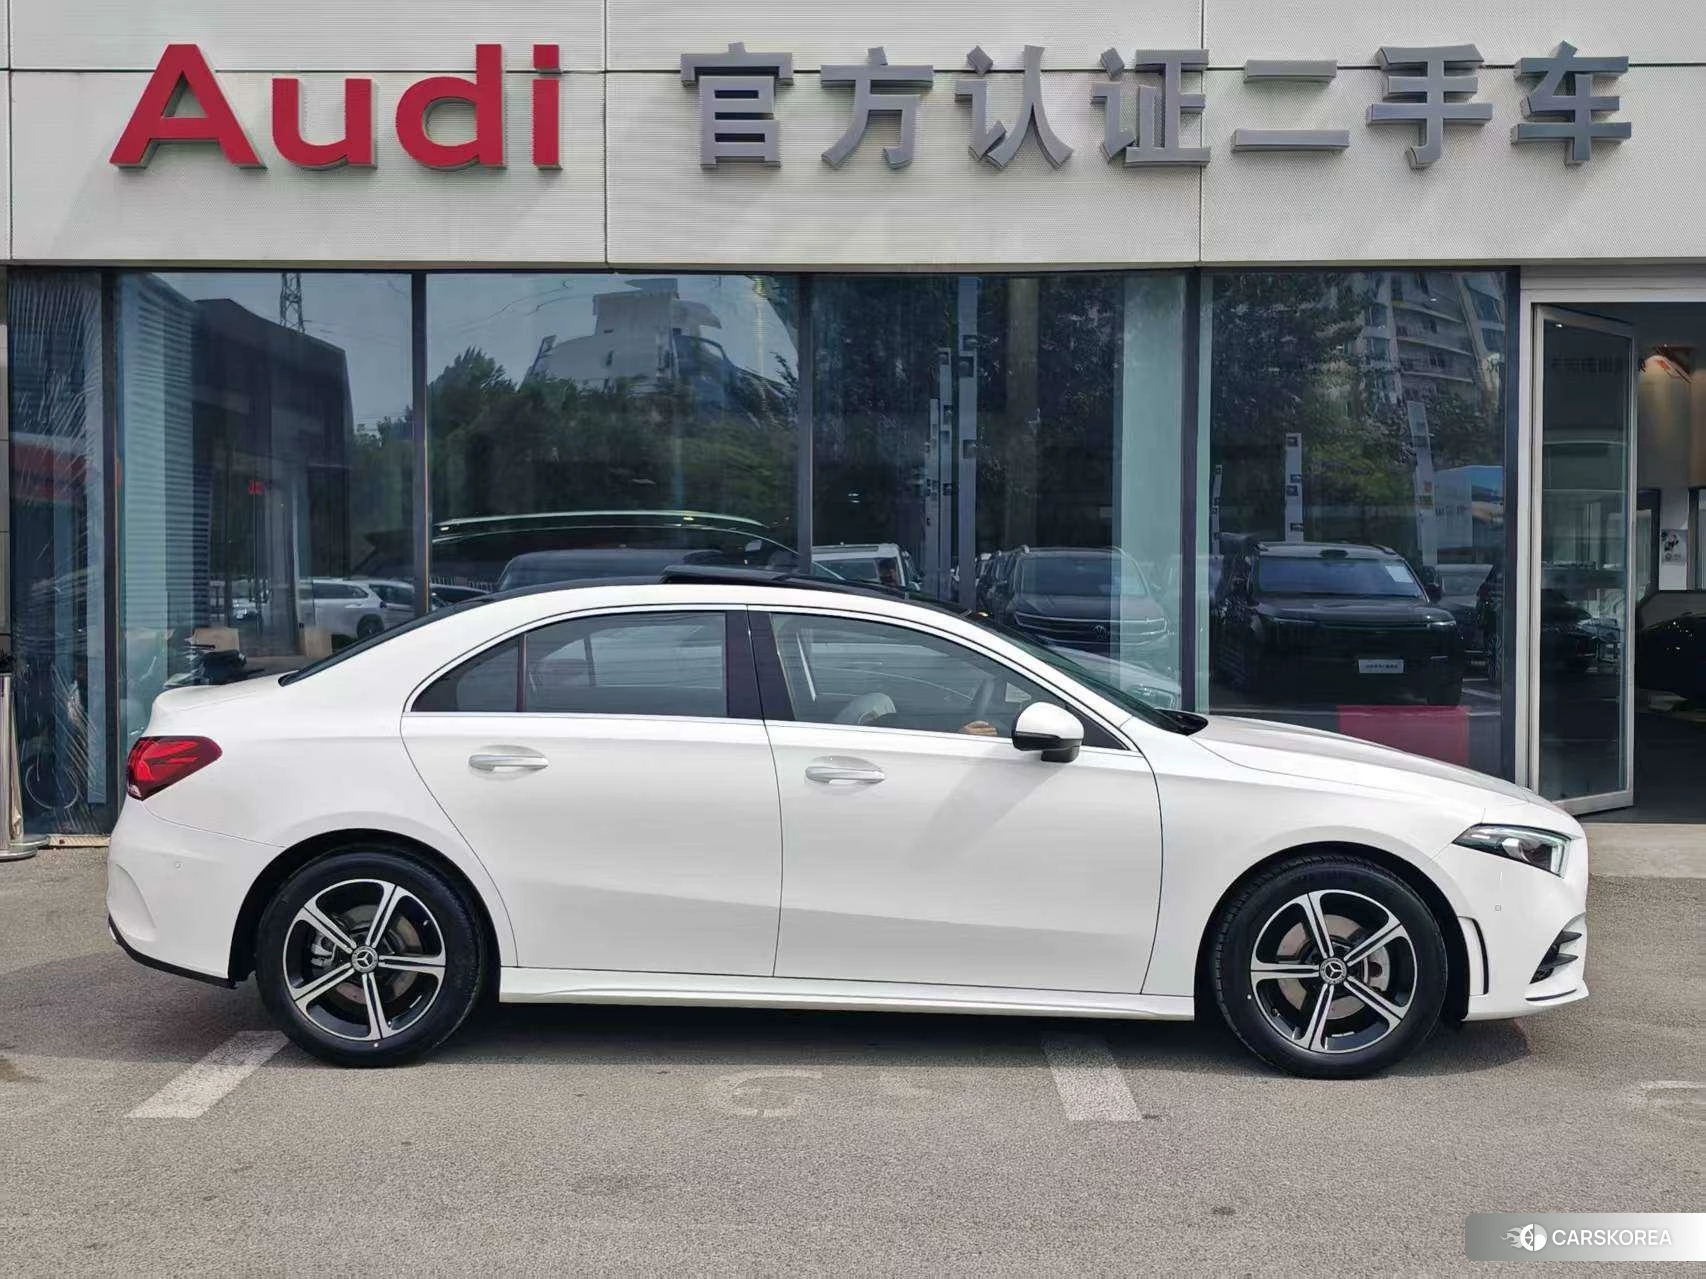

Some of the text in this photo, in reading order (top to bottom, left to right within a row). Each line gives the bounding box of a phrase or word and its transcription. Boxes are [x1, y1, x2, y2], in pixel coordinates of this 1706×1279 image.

[110, 43, 563, 170] Audi
[680, 41, 1632, 170] 官方认证二手车
